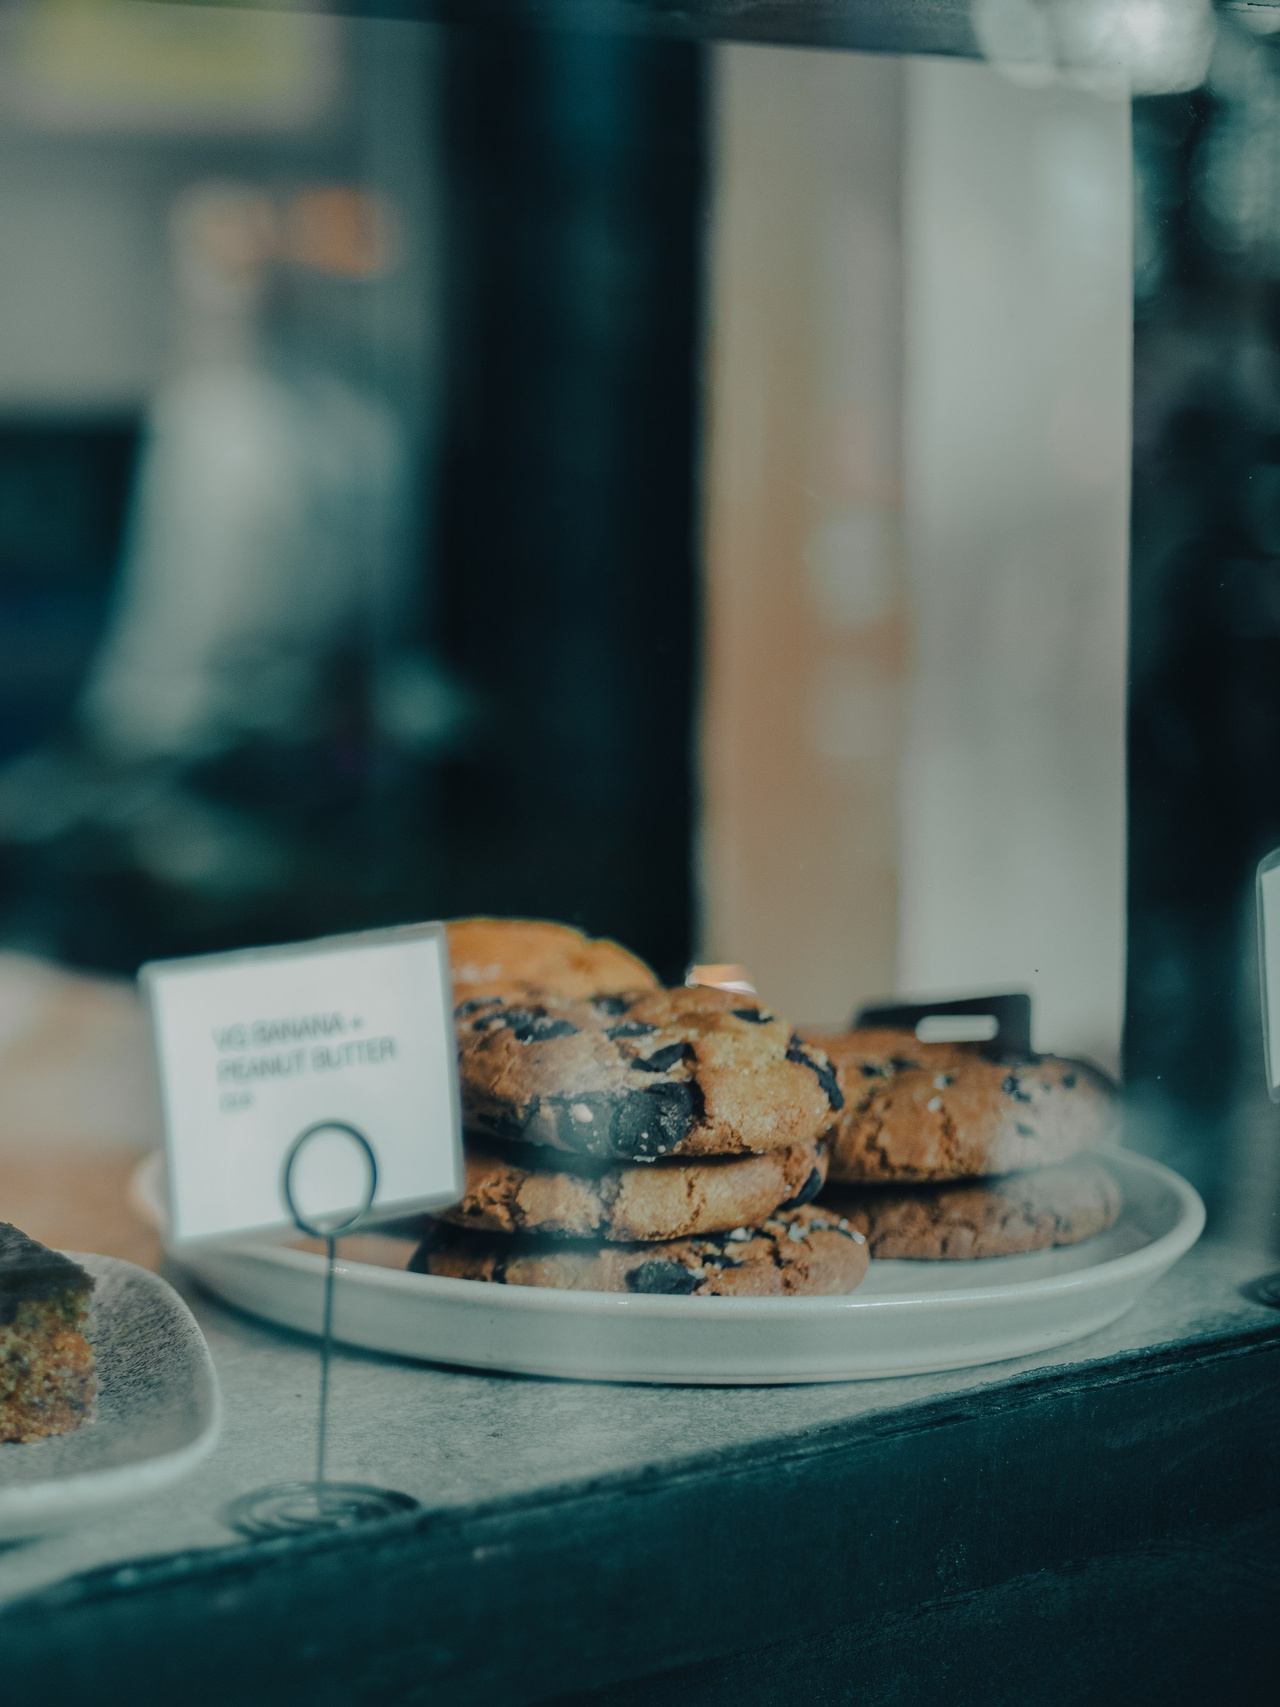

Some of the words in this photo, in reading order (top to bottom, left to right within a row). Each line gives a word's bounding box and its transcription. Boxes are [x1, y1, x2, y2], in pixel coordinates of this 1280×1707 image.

[252, 1013, 344, 1046] BANANA
[217, 1049, 306, 1083] PEANUT
[311, 1037, 396, 1072] BUTTER
